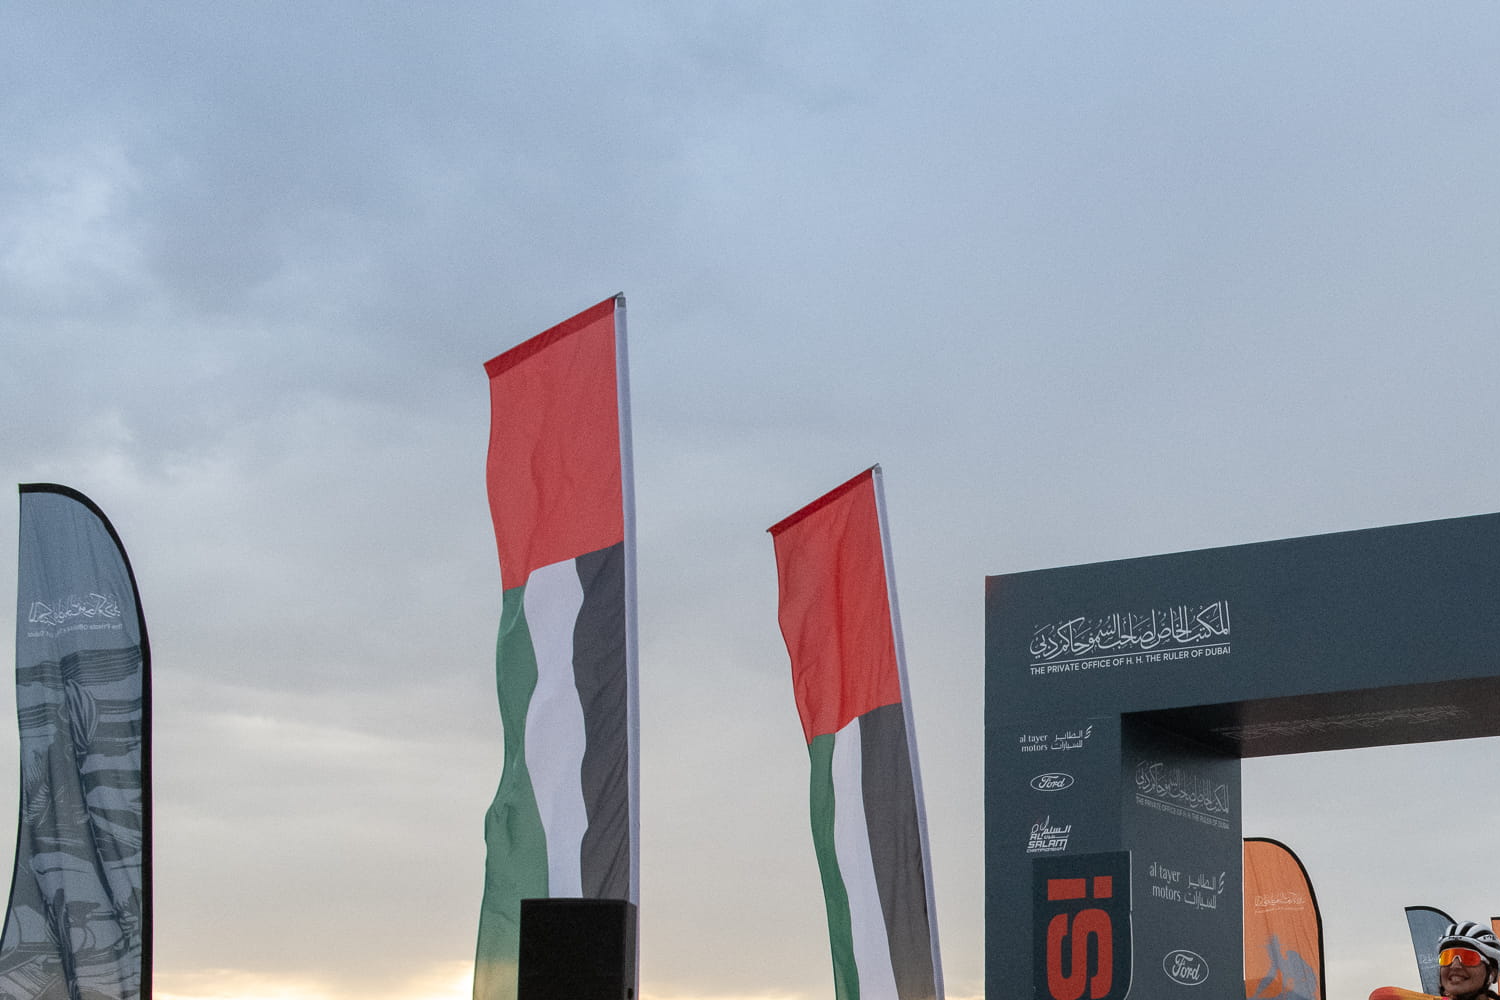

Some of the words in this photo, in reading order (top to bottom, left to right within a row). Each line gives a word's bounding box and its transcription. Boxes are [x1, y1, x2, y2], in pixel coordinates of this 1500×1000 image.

[1030, 667, 1046, 675] THE
[1047, 663, 1079, 674] PRIVATE
[1081, 659, 1110, 670] OFFICE
[1112, 657, 1124, 666] OF
[1126, 656, 1134, 665] H.
[1135, 655, 1143, 664] H.
[1146, 653, 1161, 662] THE
[1163, 650, 1189, 661] RULER
[1191, 649, 1203, 658] OF
[1205, 646, 1231, 656] DUBAI
[1021, 744, 1048, 752] motors
[1038, 775, 1065, 789] Ford
[1027, 839, 1068, 851] SALAM
[1150, 862, 1157, 877] al
[1159, 865, 1181, 884] tayer
[1152, 885, 1181, 902] motors
[1172, 953, 1200, 980] Ford
